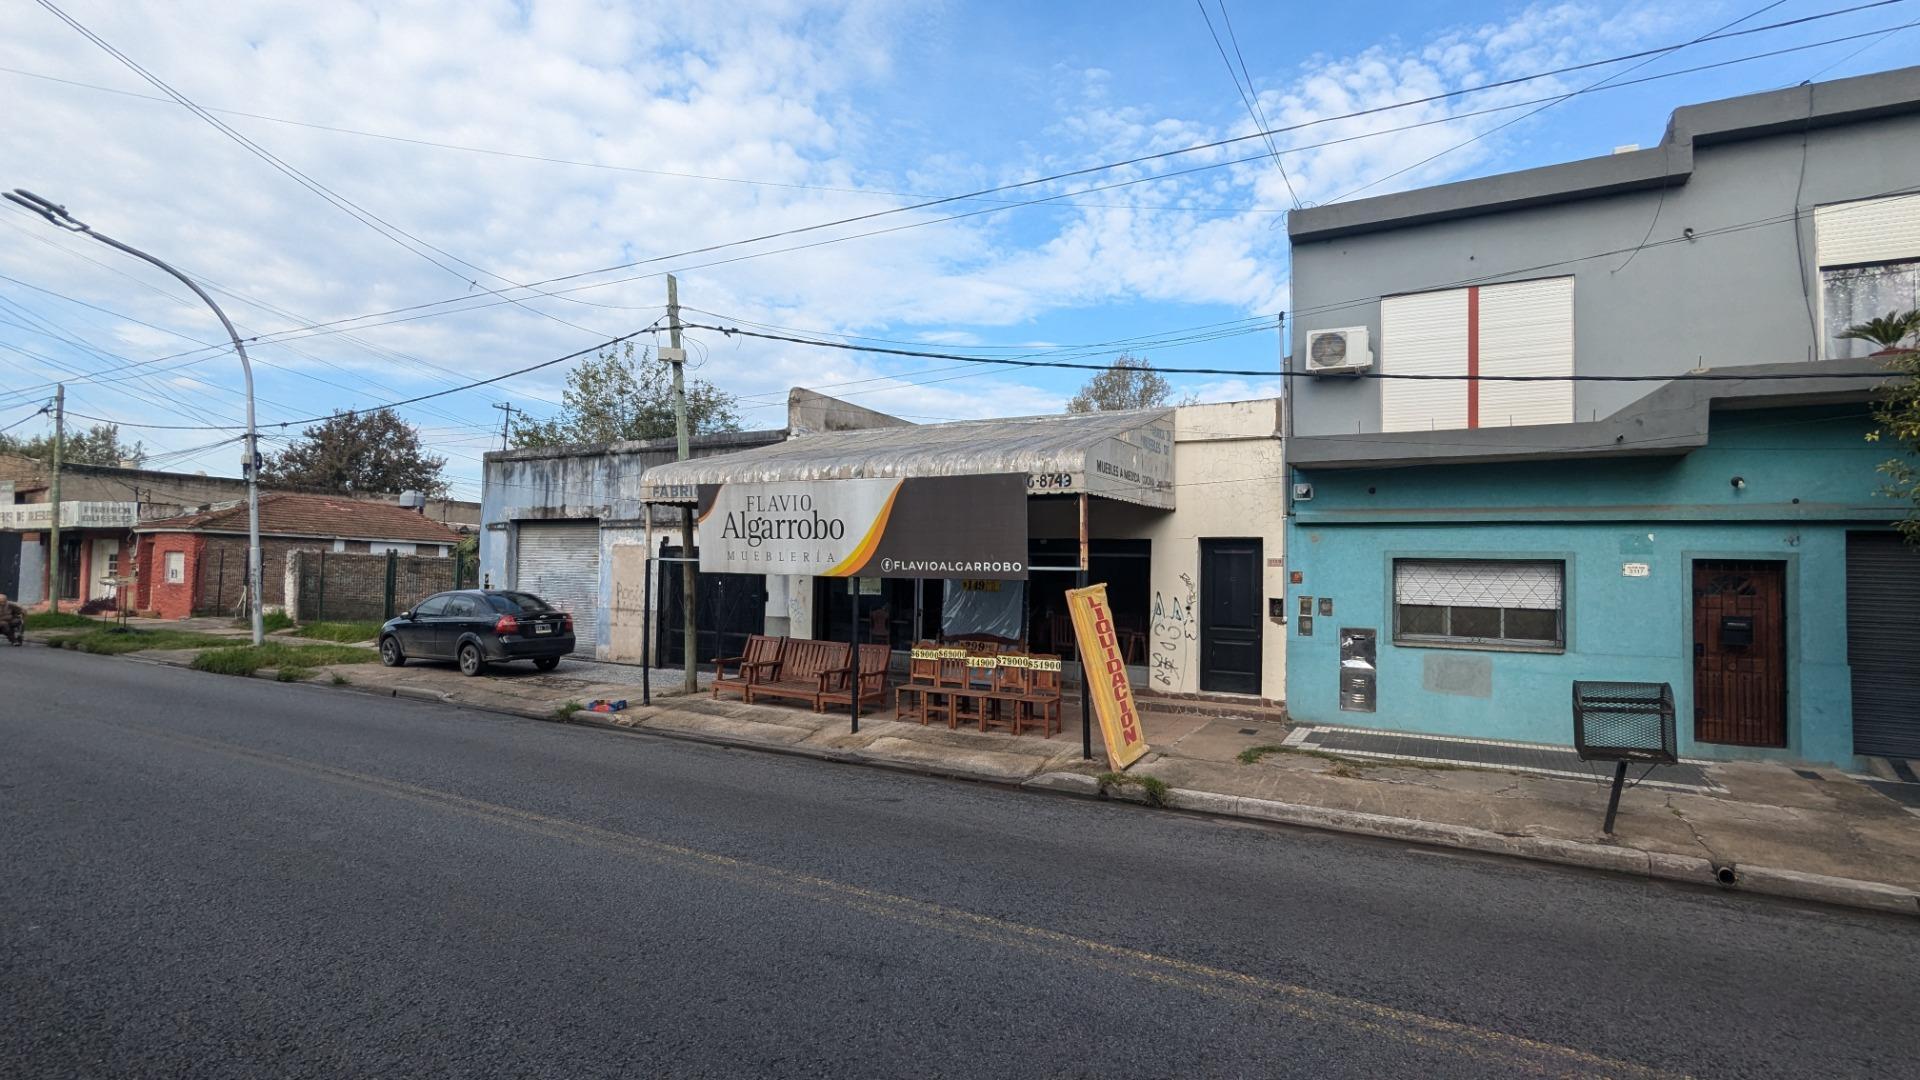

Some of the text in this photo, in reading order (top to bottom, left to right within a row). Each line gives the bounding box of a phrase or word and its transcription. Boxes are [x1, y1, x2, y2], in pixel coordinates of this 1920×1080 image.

[1096, 459, 1119, 478] MUEBLES
[746, 494, 812, 512] FLAVIO
[720, 510, 845, 547] Algarrobo
[727, 550, 835, 563] MUEBLERÍA
[894, 560, 1022, 572] FLAVIOALGARROBO
[911, 650, 938, 660] $69000
[997, 655, 1028, 667] $79000
